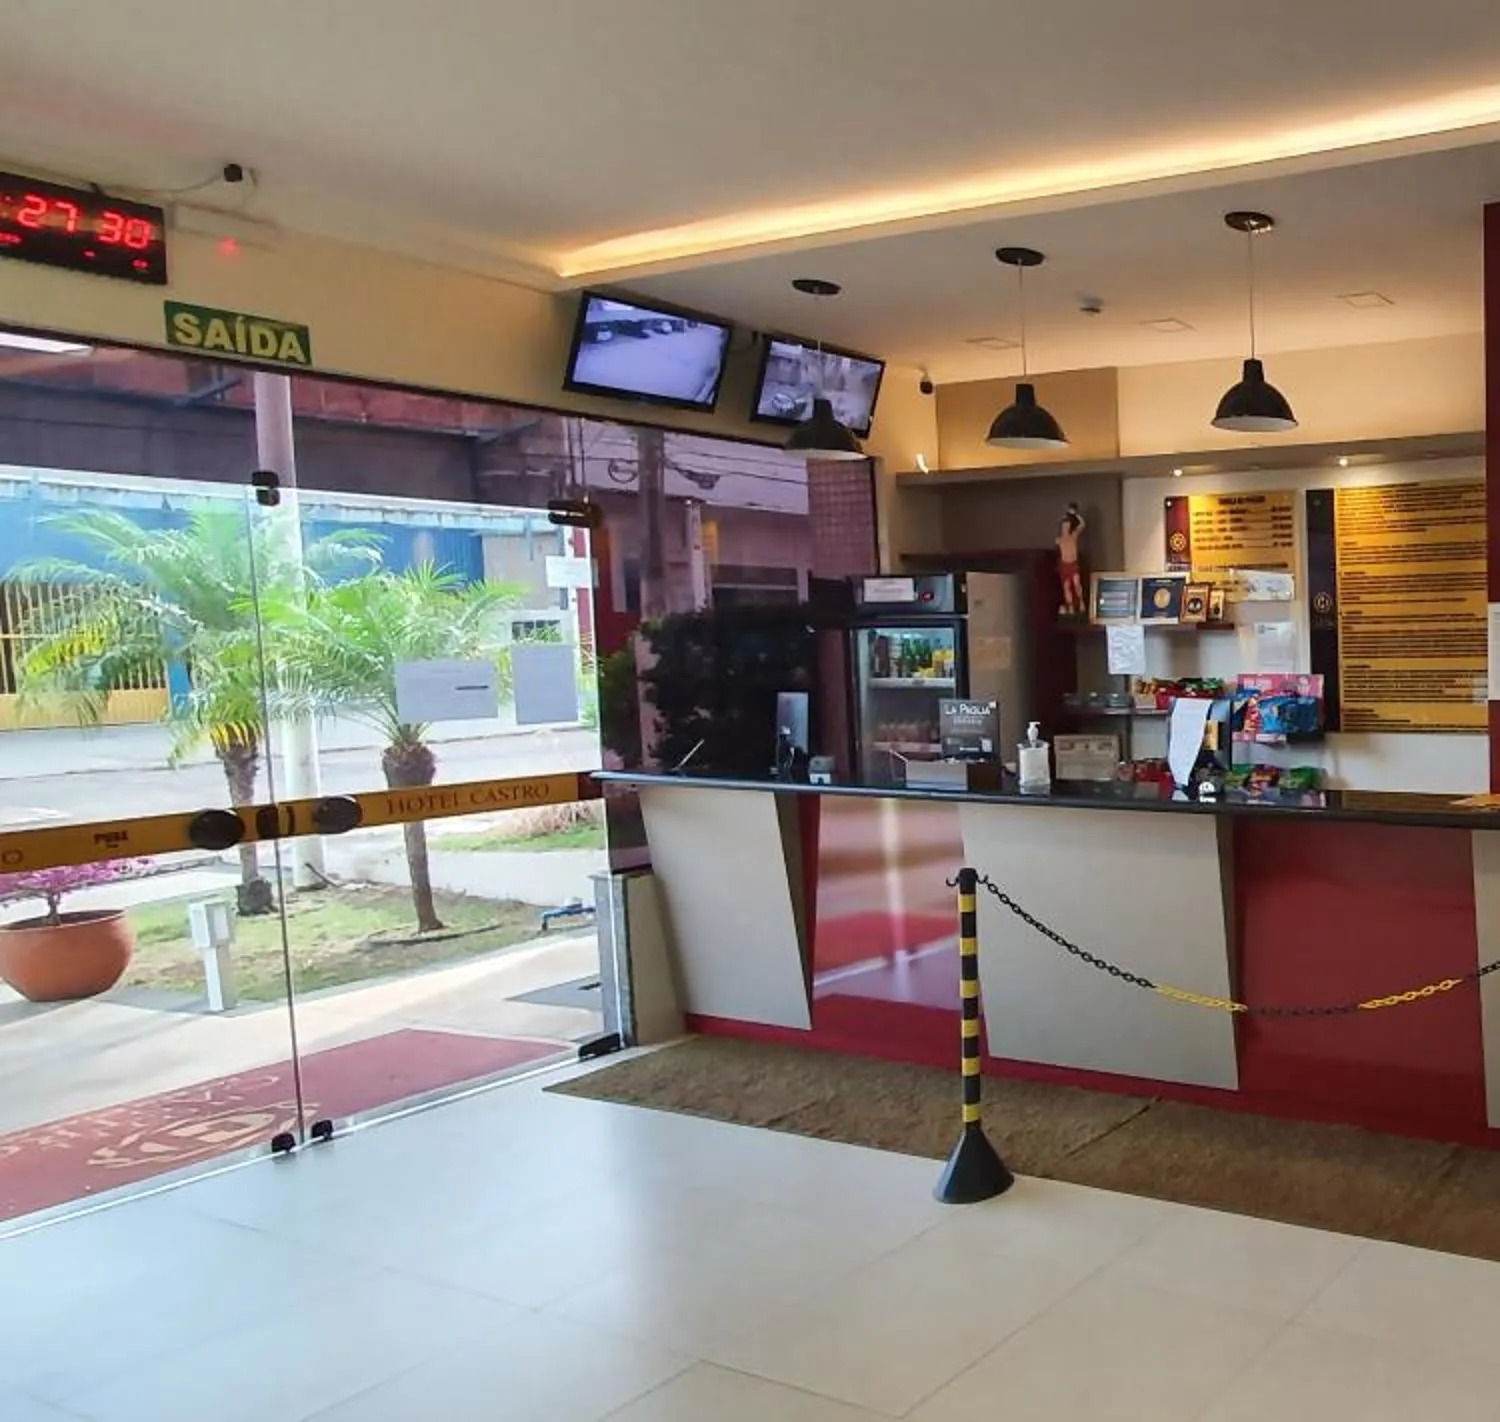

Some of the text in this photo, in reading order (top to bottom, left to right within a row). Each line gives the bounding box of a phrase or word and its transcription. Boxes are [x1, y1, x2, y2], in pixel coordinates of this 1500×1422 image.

[98, 211, 151, 250] 30
[172, 310, 306, 363] SAÍDA
[386, 782, 550, 816] HOTEL CASTRO
